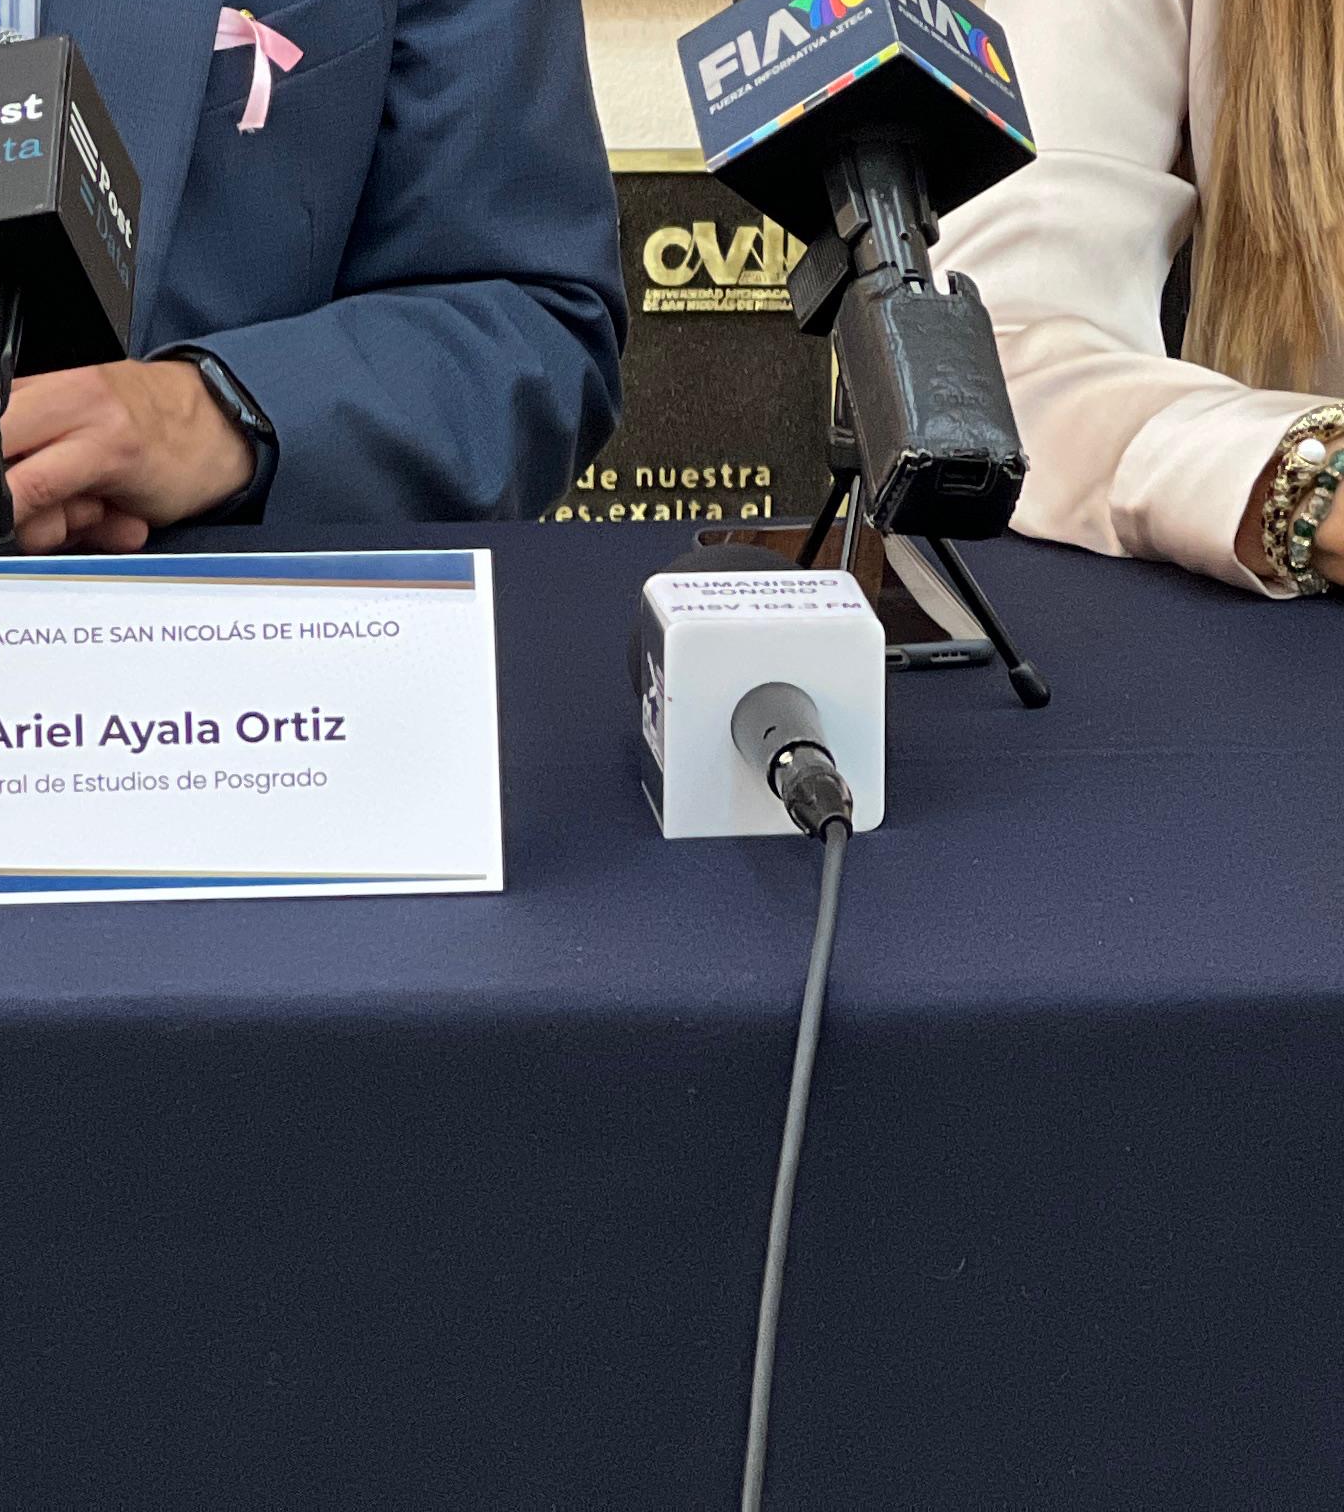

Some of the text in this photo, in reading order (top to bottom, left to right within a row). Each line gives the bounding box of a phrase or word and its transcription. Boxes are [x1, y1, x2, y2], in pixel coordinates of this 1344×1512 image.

[699, 8, 811, 101] FIA
[709, 7, 873, 115] FUERZA INFORMATIVA AZTECA
[98, 160, 132, 249] Post
[96, 201, 129, 291] Data
[636, 464, 771, 489] nuestra
[609, 499, 723, 521] exalta
[741, 494, 772, 520] el
[672, 579, 838, 588] HUMANISMO
[671, 603, 741, 612] XHSV
[749, 602, 818, 610] 104.3
[74, 628, 102, 643] DE
[110, 627, 152, 642] SAN
[161, 620, 255, 641] NICOLÁS
[263, 624, 291, 639] DE
[300, 620, 399, 638] HIDALGO
[99, 711, 219, 754] Ayala
[236, 707, 345, 743] Ortiz
[35, 774, 65, 793] de
[73, 771, 169, 792] Estudios
[177, 770, 206, 790] de
[214, 767, 327, 794] Posgrado
